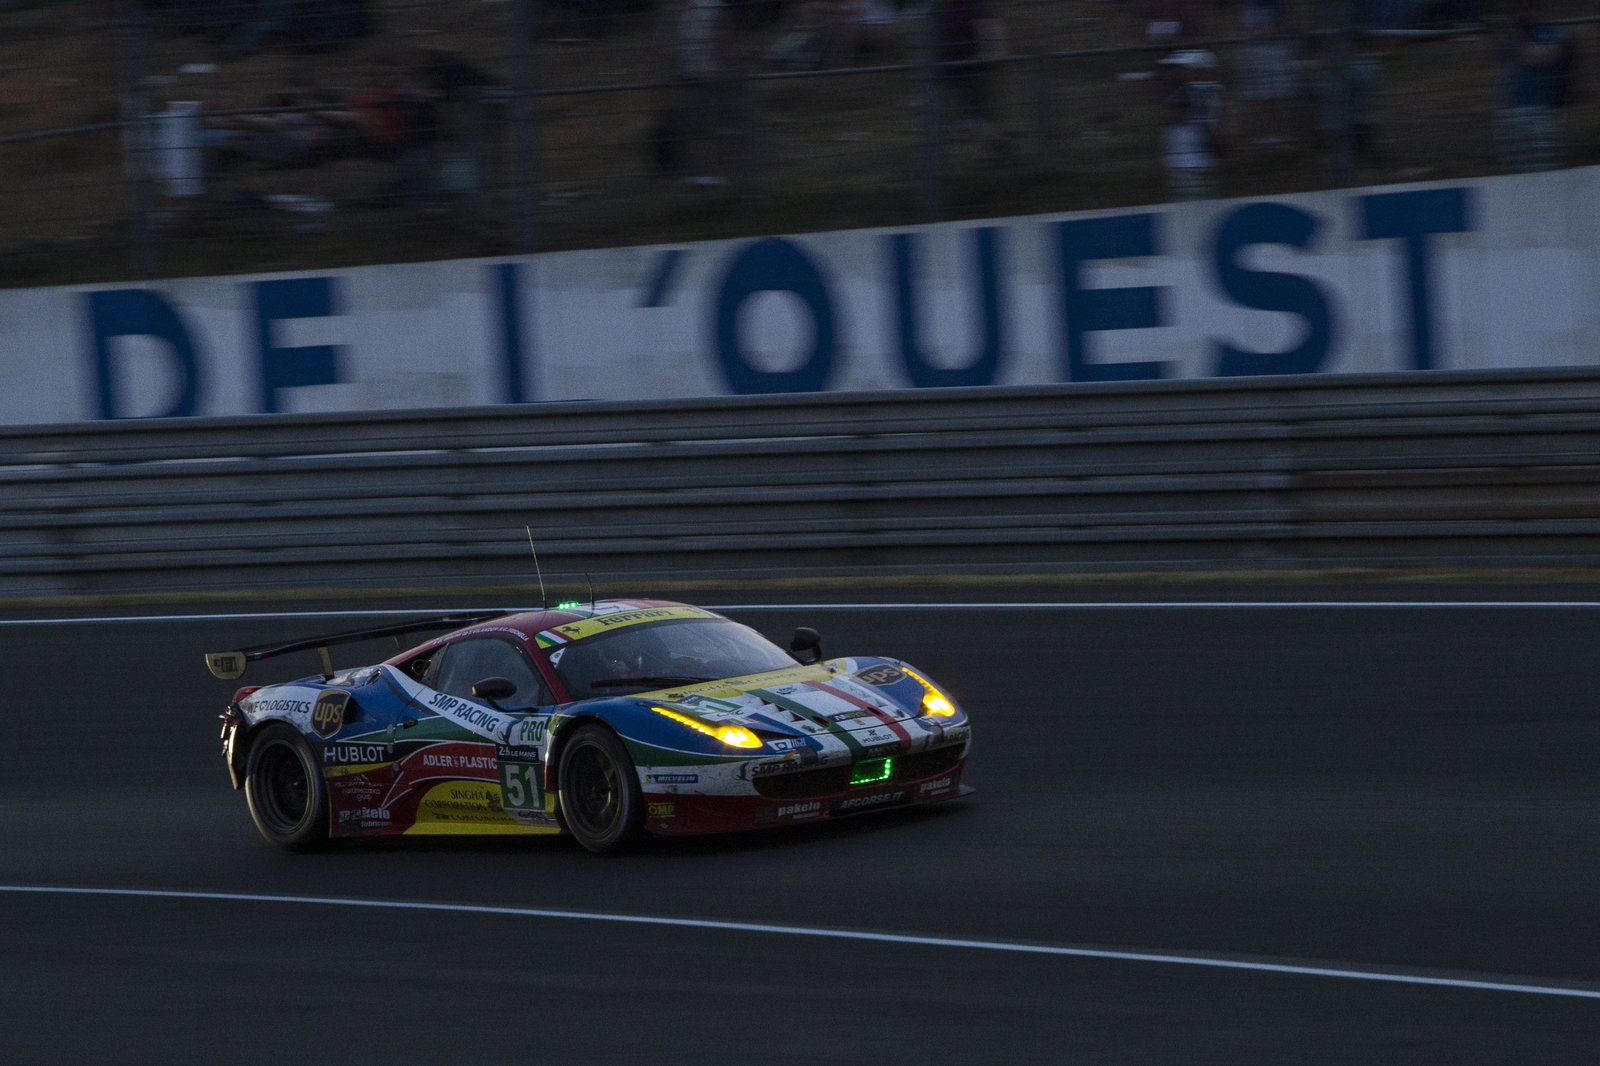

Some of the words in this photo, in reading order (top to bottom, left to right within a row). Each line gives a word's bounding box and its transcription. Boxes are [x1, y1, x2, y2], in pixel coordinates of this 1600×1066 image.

[594, 608, 676, 626] Ferrari
[862, 667, 900, 683] ups
[268, 699, 311, 714] LOGISTICS
[429, 693, 457, 711] SMP
[454, 703, 499, 732] RACING
[314, 702, 342, 729] ups
[520, 721, 544, 741] PRO
[863, 733, 893, 743] HUBLOT
[324, 746, 384, 762] HUBLOT
[423, 755, 453, 767] ADLER
[460, 756, 497, 769] PLASTIC
[752, 764, 779, 777] SMP
[505, 764, 540, 808] 51
[657, 775, 696, 783] MICHELIN
[451, 790, 483, 800] SINGHA
[424, 800, 490, 812] CORPORATION
[648, 804, 675, 816] OMP
[778, 801, 820, 816] pakelo
[337, 806, 391, 822] pakelo
